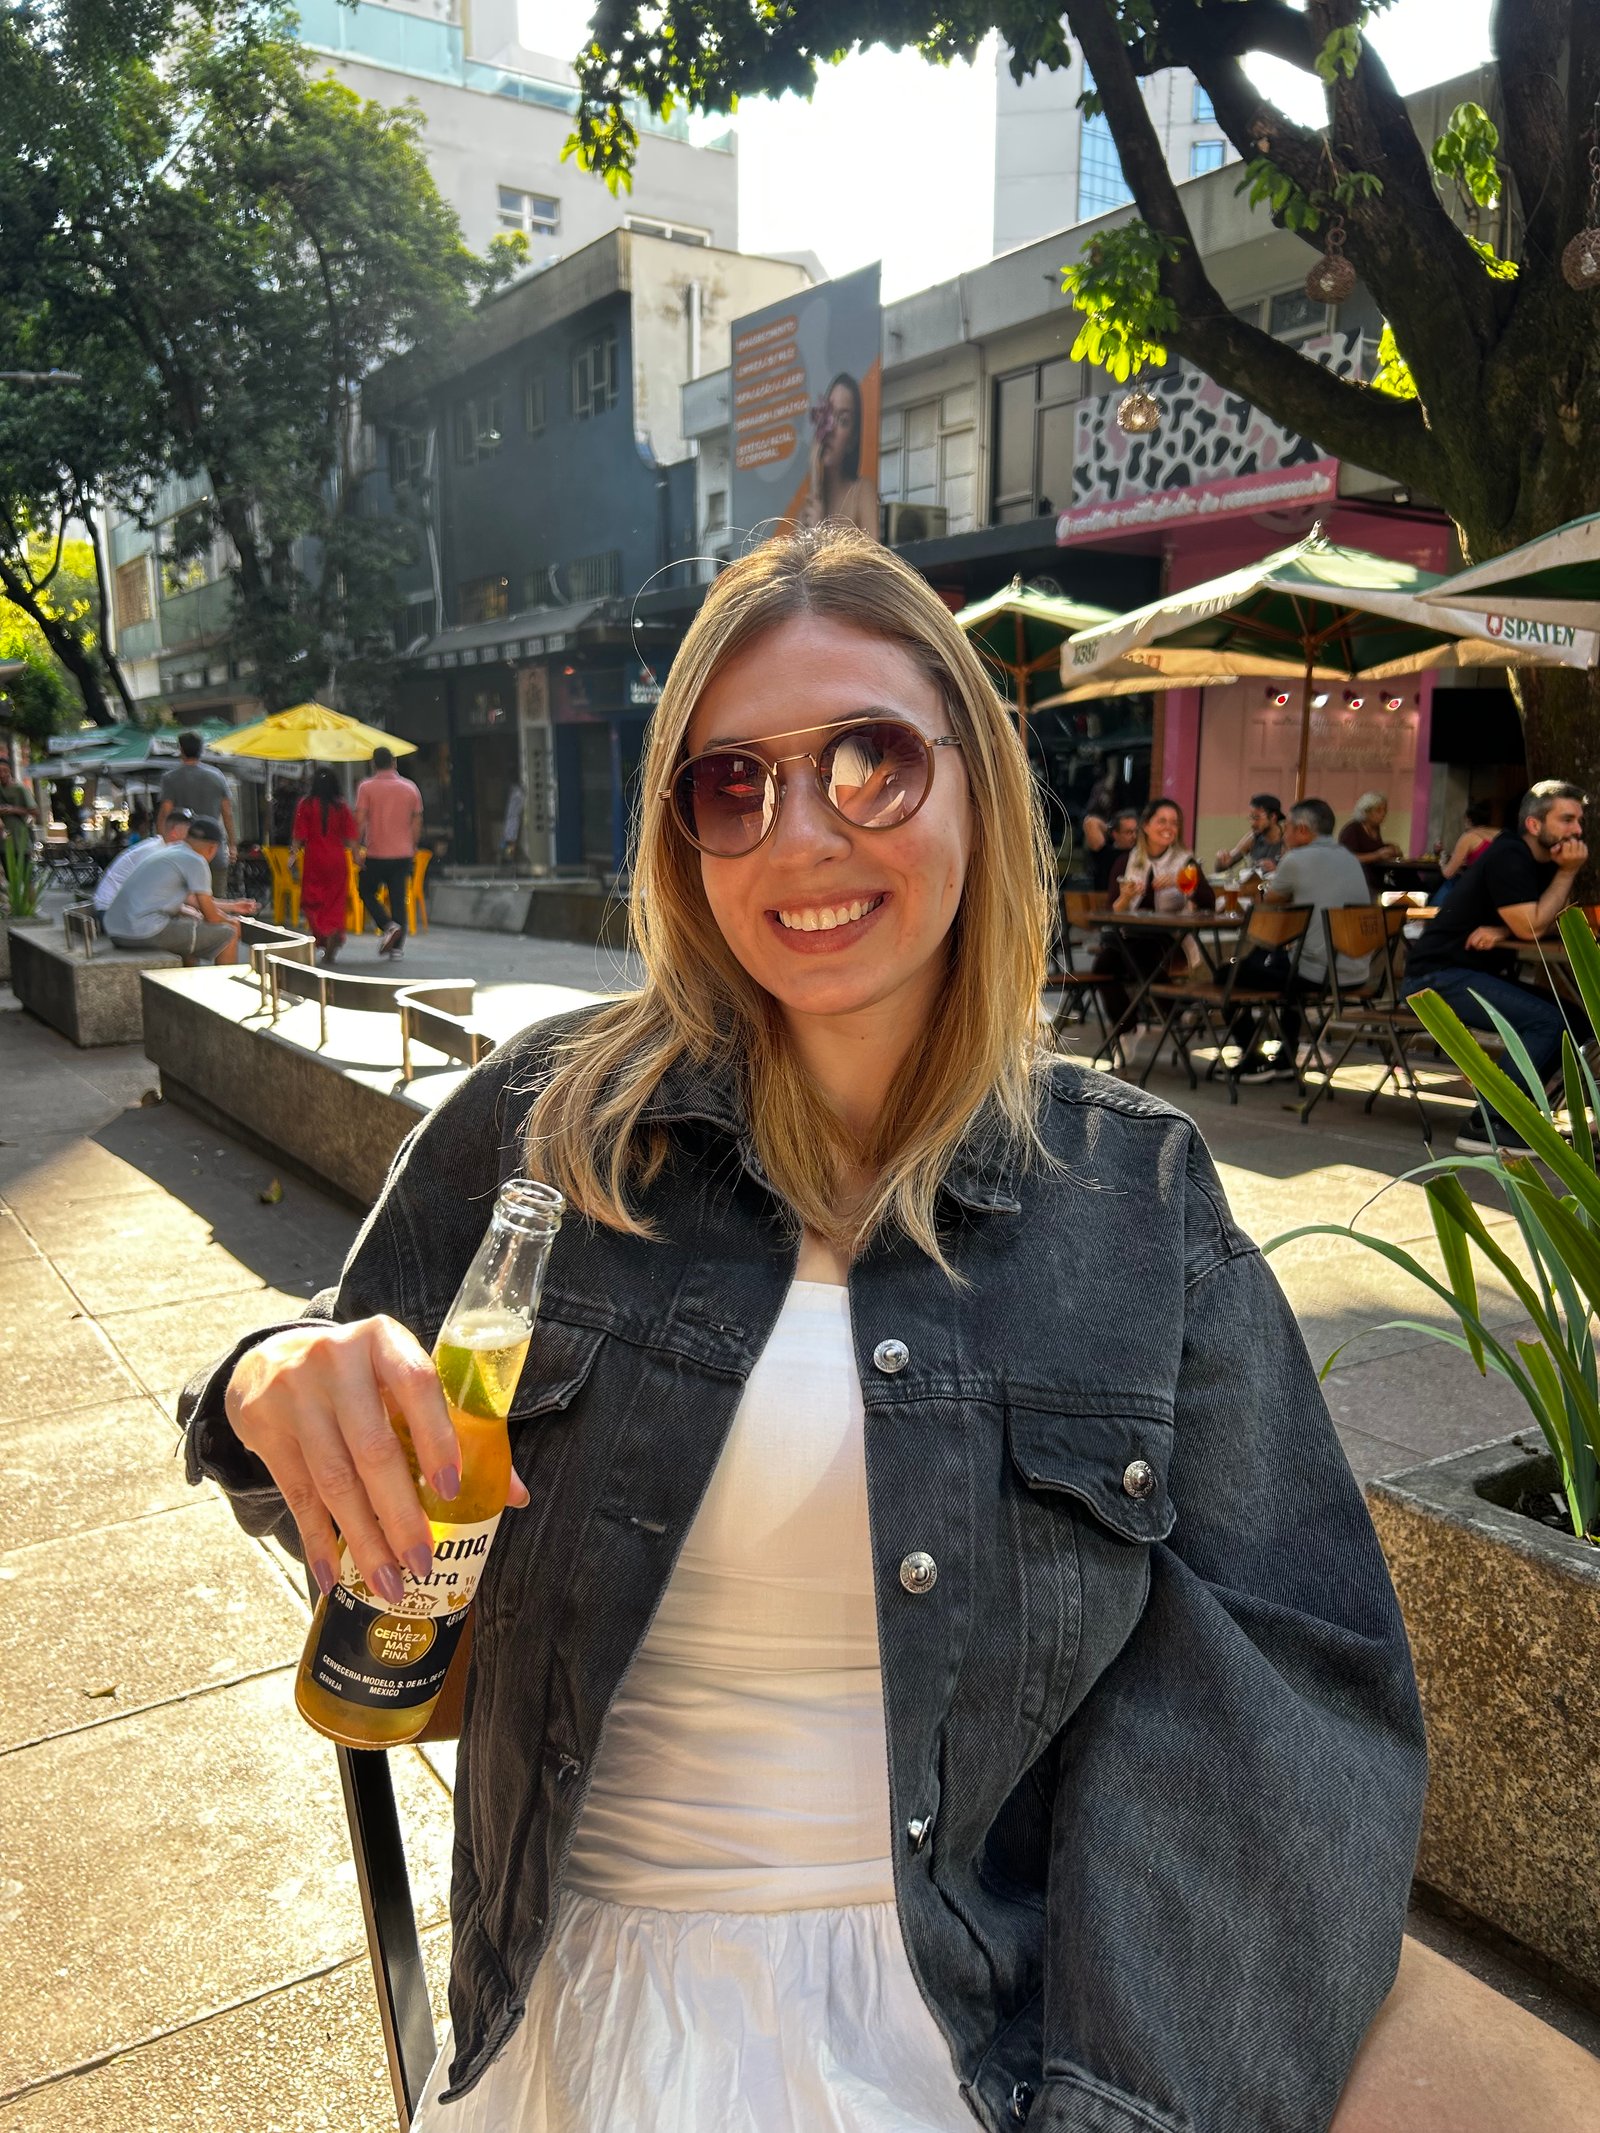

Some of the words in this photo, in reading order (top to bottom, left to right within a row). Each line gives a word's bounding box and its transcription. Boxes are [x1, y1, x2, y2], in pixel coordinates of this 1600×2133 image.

[1504, 616, 1576, 647] SPATEN
[432, 1533, 489, 1562] ona
[401, 1566, 459, 1587] xtra
[345, 1598, 355, 1611] ml
[374, 1627, 428, 1642] CERVEZA
[396, 1623, 412, 1633] LA
[385, 1640, 412, 1652] MAS
[381, 1649, 409, 1661] FINA
[322, 1654, 361, 1682] CERVECERIA
[362, 1675, 396, 1690] MODELO,
[398, 1681, 405, 1689] S.
[406, 1680, 416, 1689] DE
[319, 1671, 343, 1692] CERVEJA
[369, 1686, 400, 1698] MEXICO
